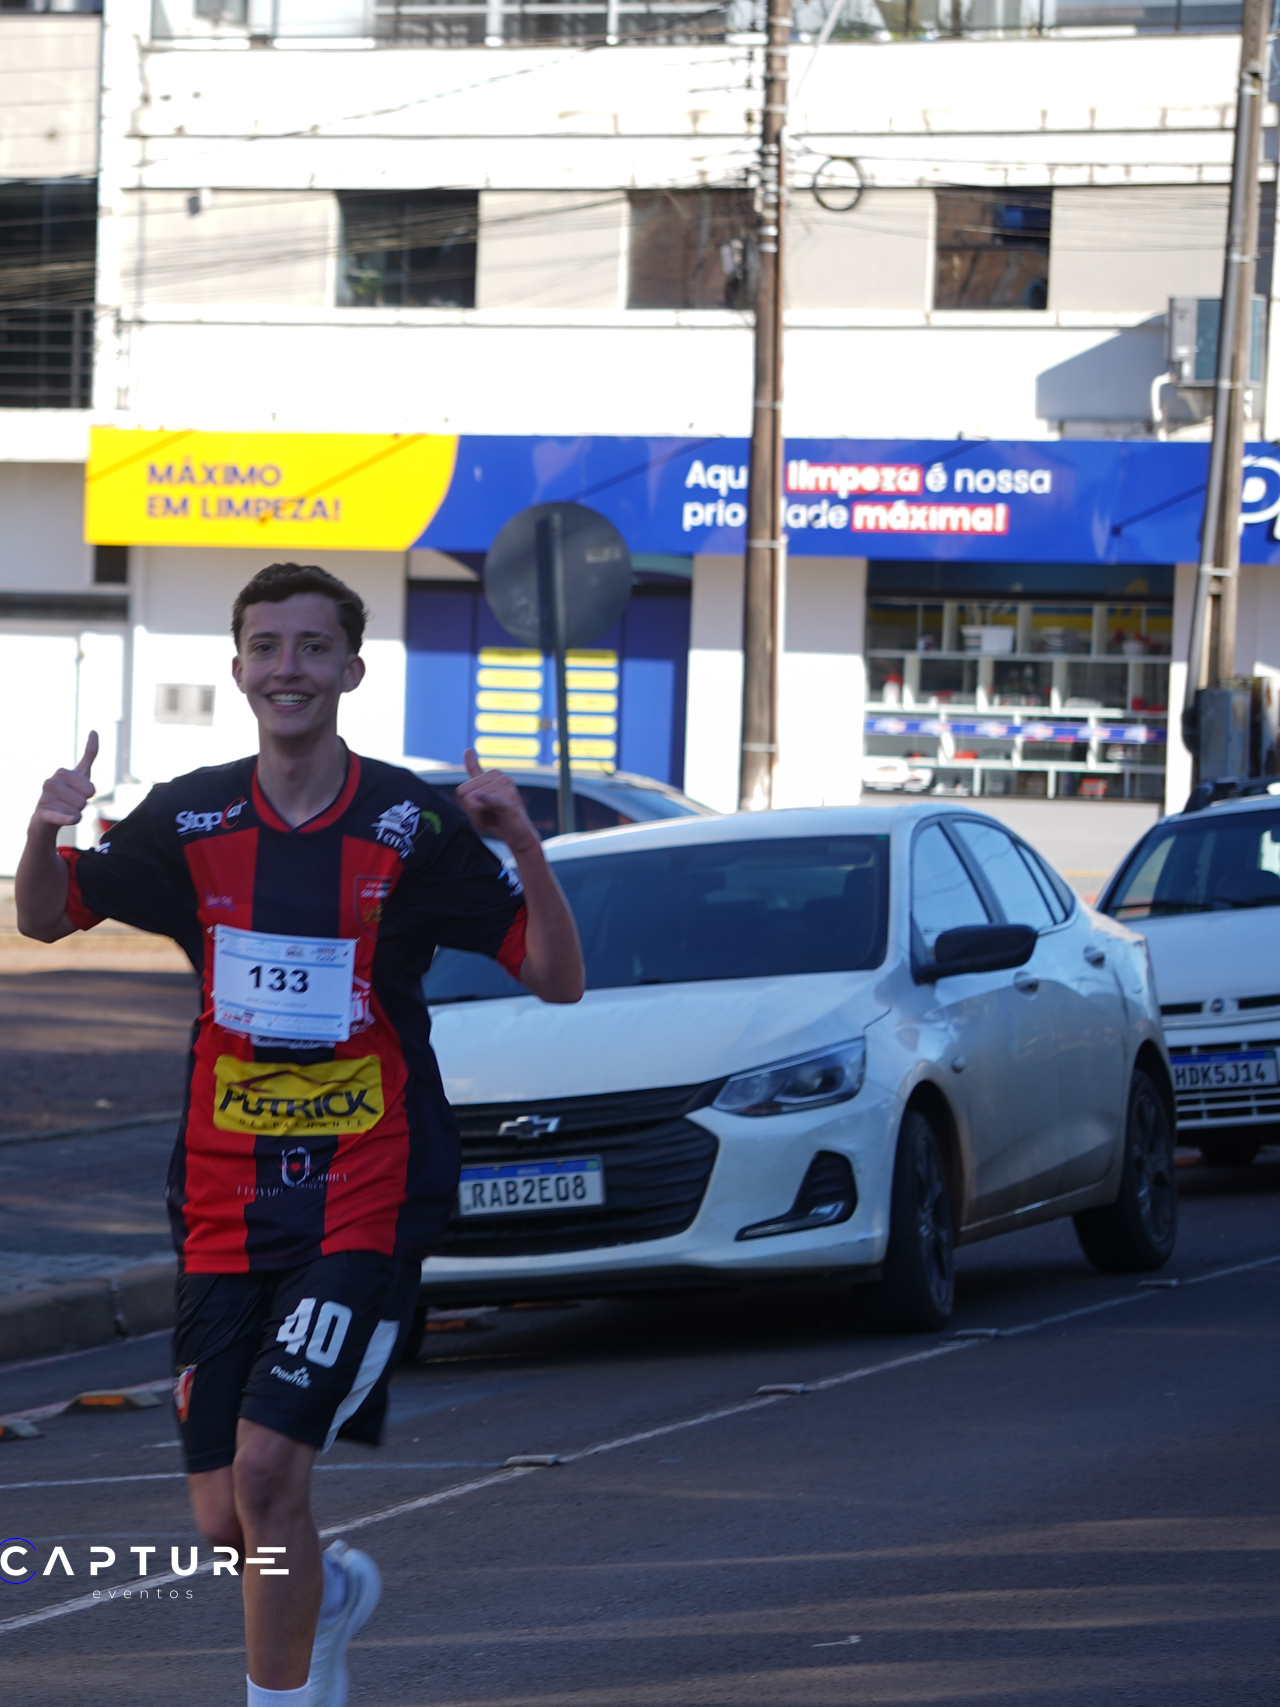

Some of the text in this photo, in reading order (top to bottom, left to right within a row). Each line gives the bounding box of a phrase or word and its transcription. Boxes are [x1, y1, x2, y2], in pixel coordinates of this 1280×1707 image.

[147, 455, 282, 487] MÁXIMO
[685, 459, 1053, 499] Aqu limpeza é nossa
[147, 496, 342, 523] EM LIMPEZA!
[852, 500, 1008, 532] máxima!
[248, 965, 310, 993] 133
[1174, 1063, 1267, 1087] HDK5J14
[472, 1174, 587, 1209] RAB2E08
[276, 1297, 353, 1369] 40
